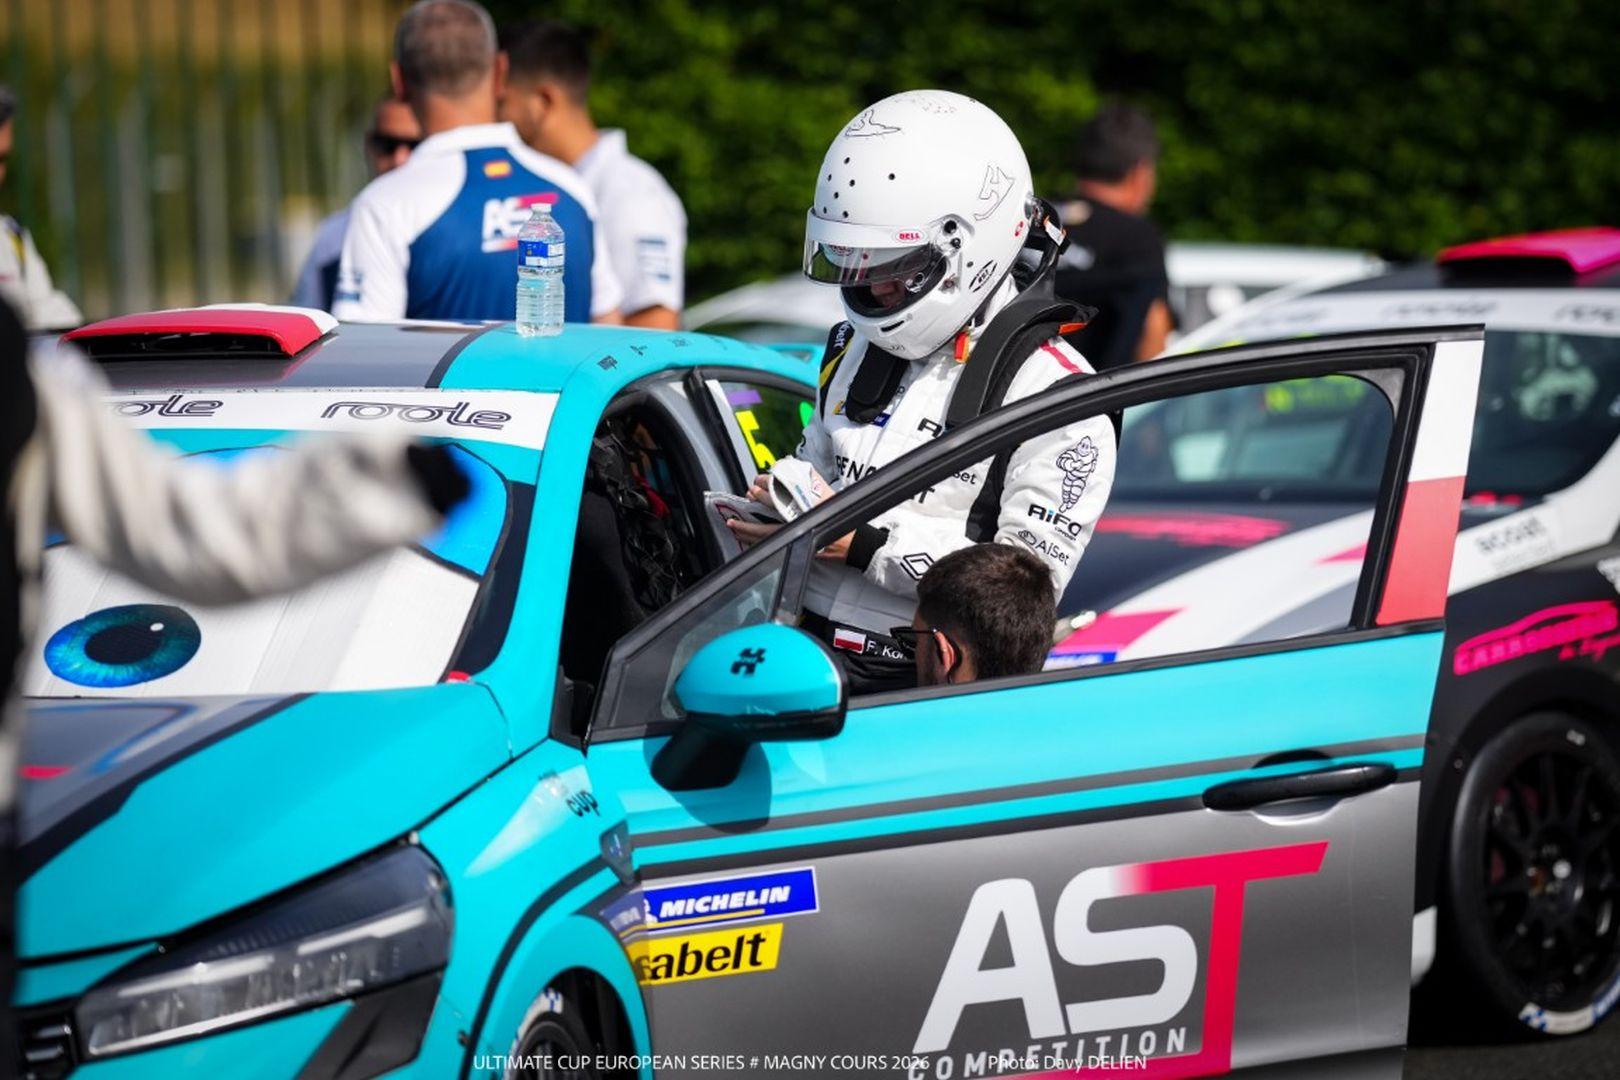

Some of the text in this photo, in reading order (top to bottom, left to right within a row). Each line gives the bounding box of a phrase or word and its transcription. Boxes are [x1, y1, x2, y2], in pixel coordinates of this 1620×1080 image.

[898, 232, 921, 242] BELL
[565, 790, 600, 817] cup
[659, 886, 791, 918] MICHELIN
[913, 841, 1329, 1075] AST
[907, 1027, 1187, 1080] COMPETITION
